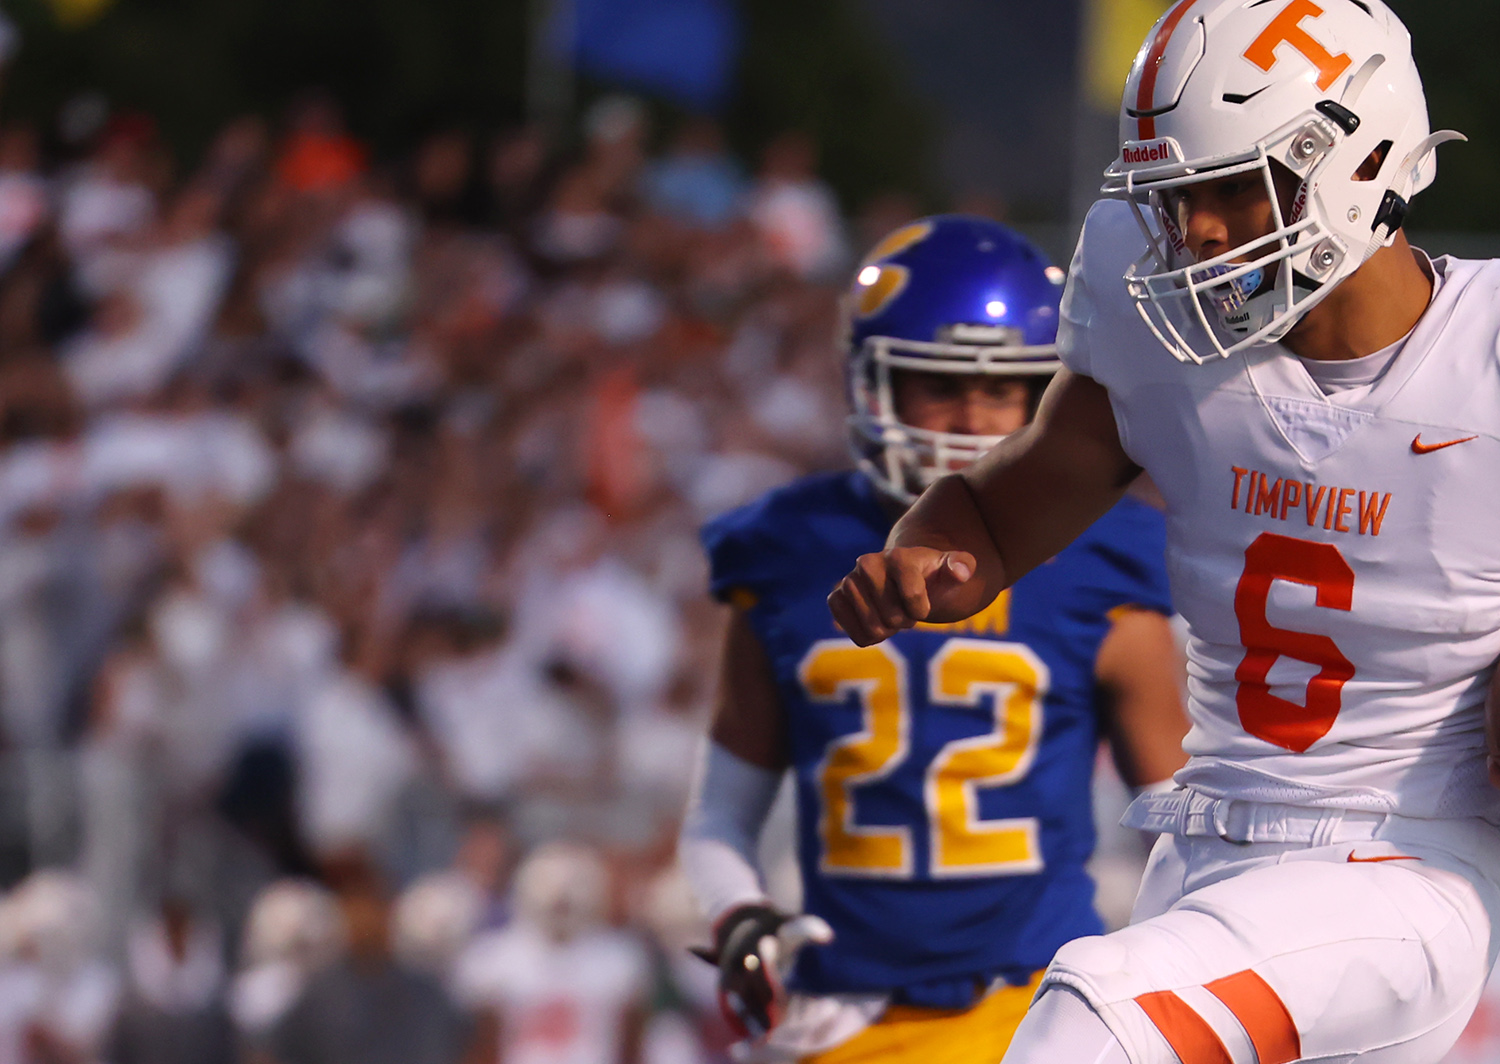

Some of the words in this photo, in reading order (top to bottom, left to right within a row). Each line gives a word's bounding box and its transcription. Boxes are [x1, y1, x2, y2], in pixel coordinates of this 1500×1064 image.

[1242, 0, 1353, 93] T
[1123, 143, 1169, 164] Riddell
[1231, 465, 1393, 537] TIMPVIEW
[1234, 531, 1356, 754] 6
[797, 638, 1050, 878] 22
